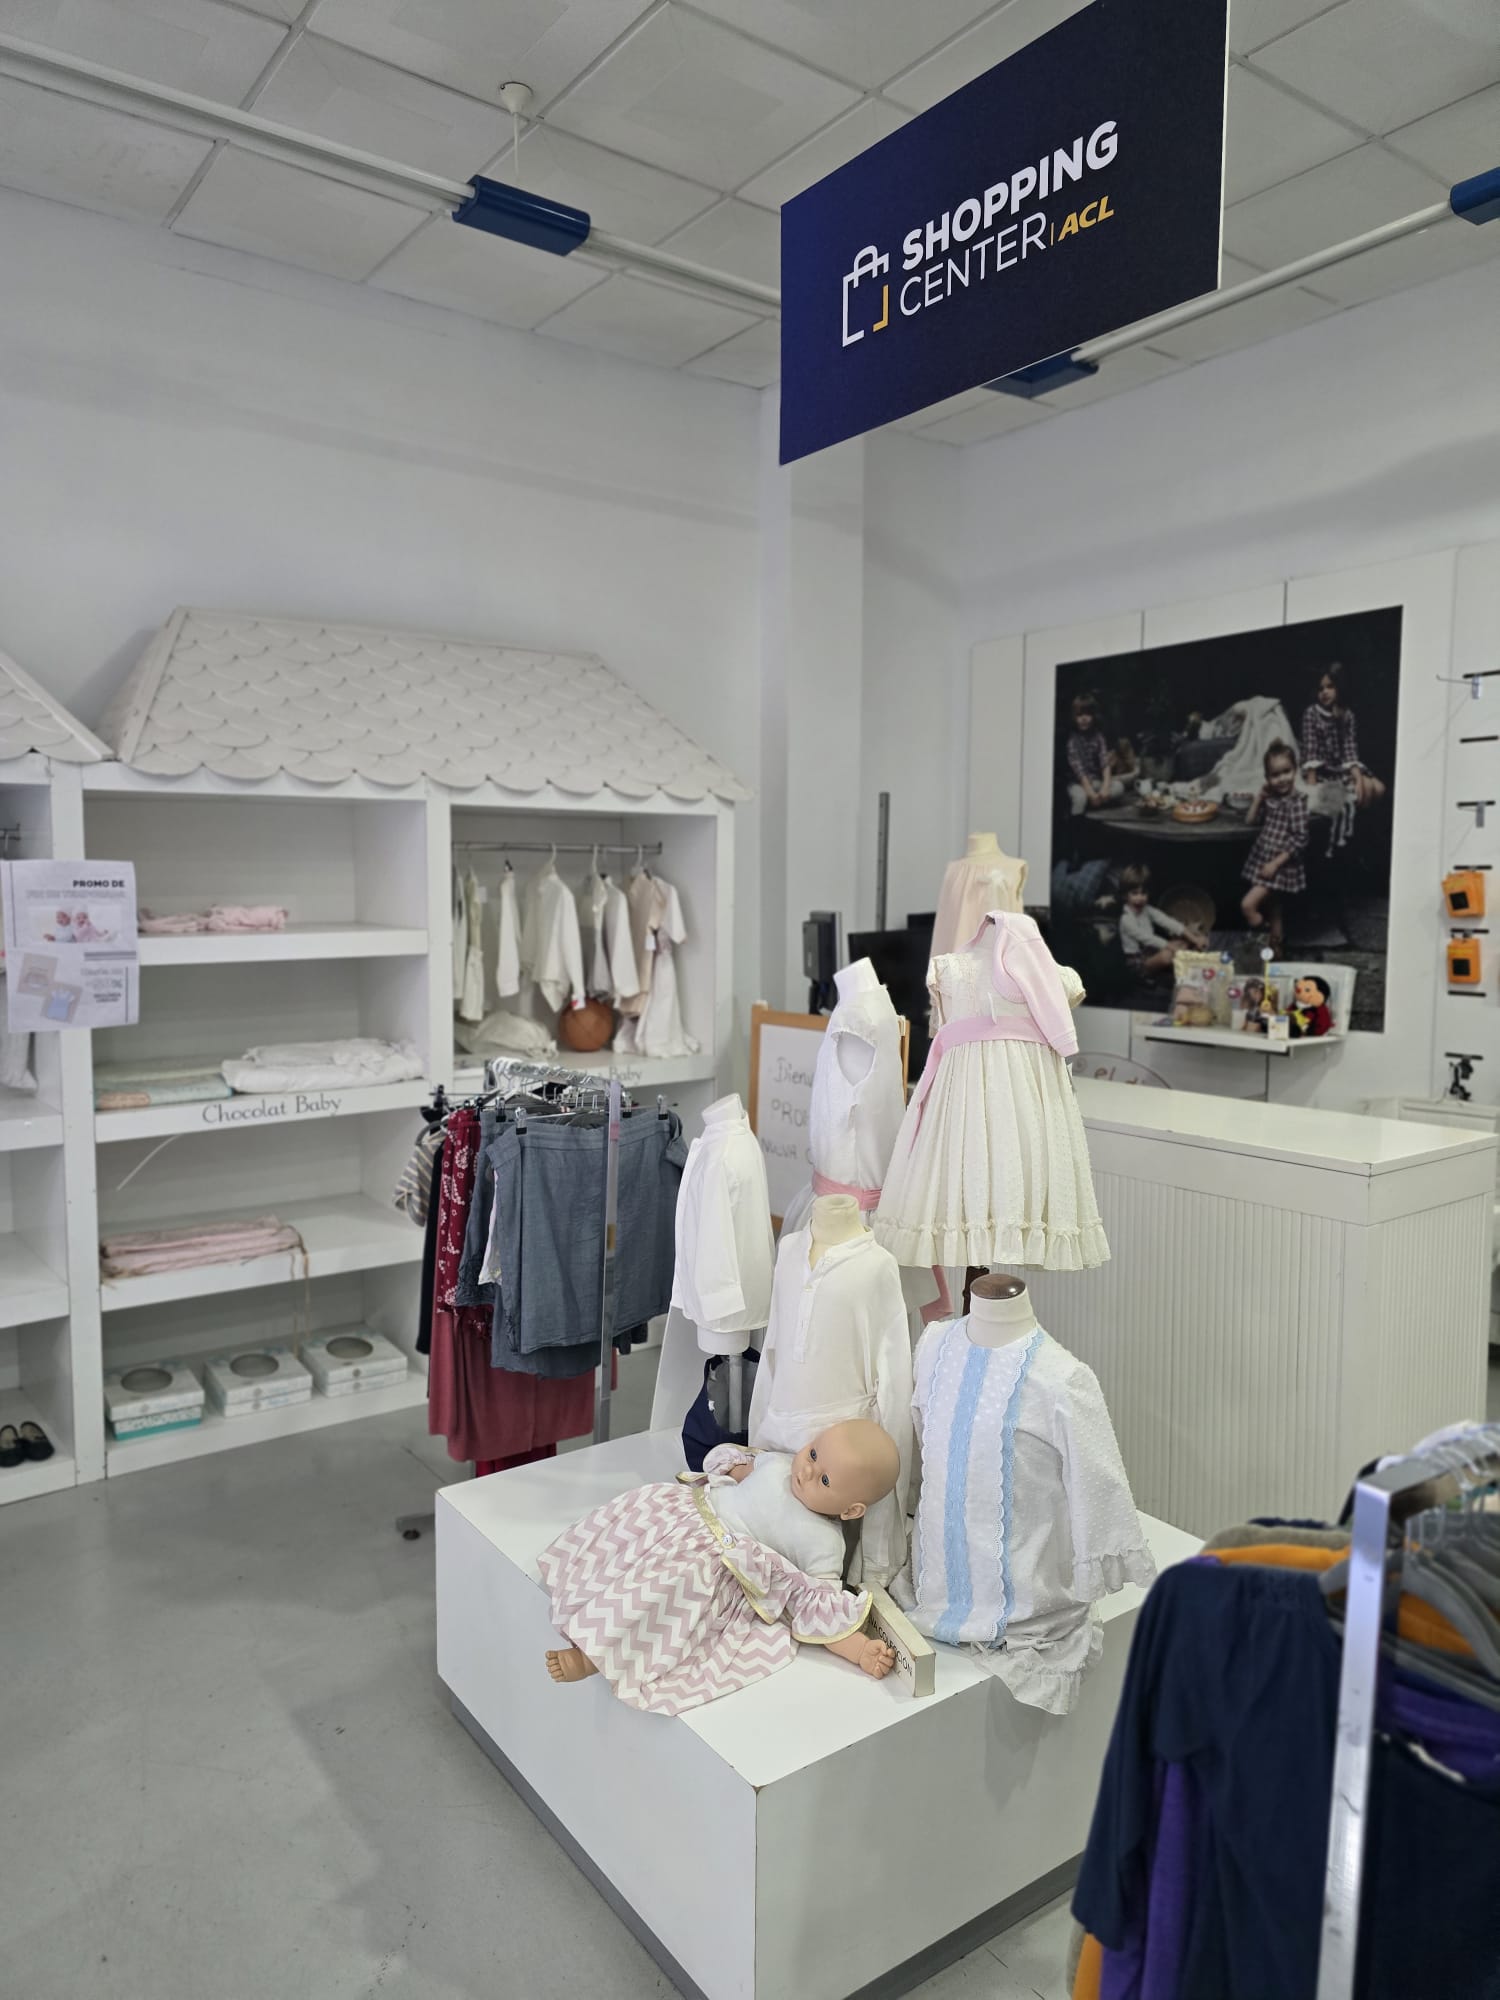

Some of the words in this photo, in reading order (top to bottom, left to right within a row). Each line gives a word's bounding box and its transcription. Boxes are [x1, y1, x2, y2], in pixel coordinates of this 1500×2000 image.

[902, 120, 1118, 270] SHOPPING
[900, 212, 1047, 316] CENTER
[1058, 195, 1114, 242] ACL
[72, 879, 110, 888] PROMO
[111, 879, 125, 888] DE
[202, 1099, 286, 1123] Chocolat
[295, 1092, 342, 1117] Baby
